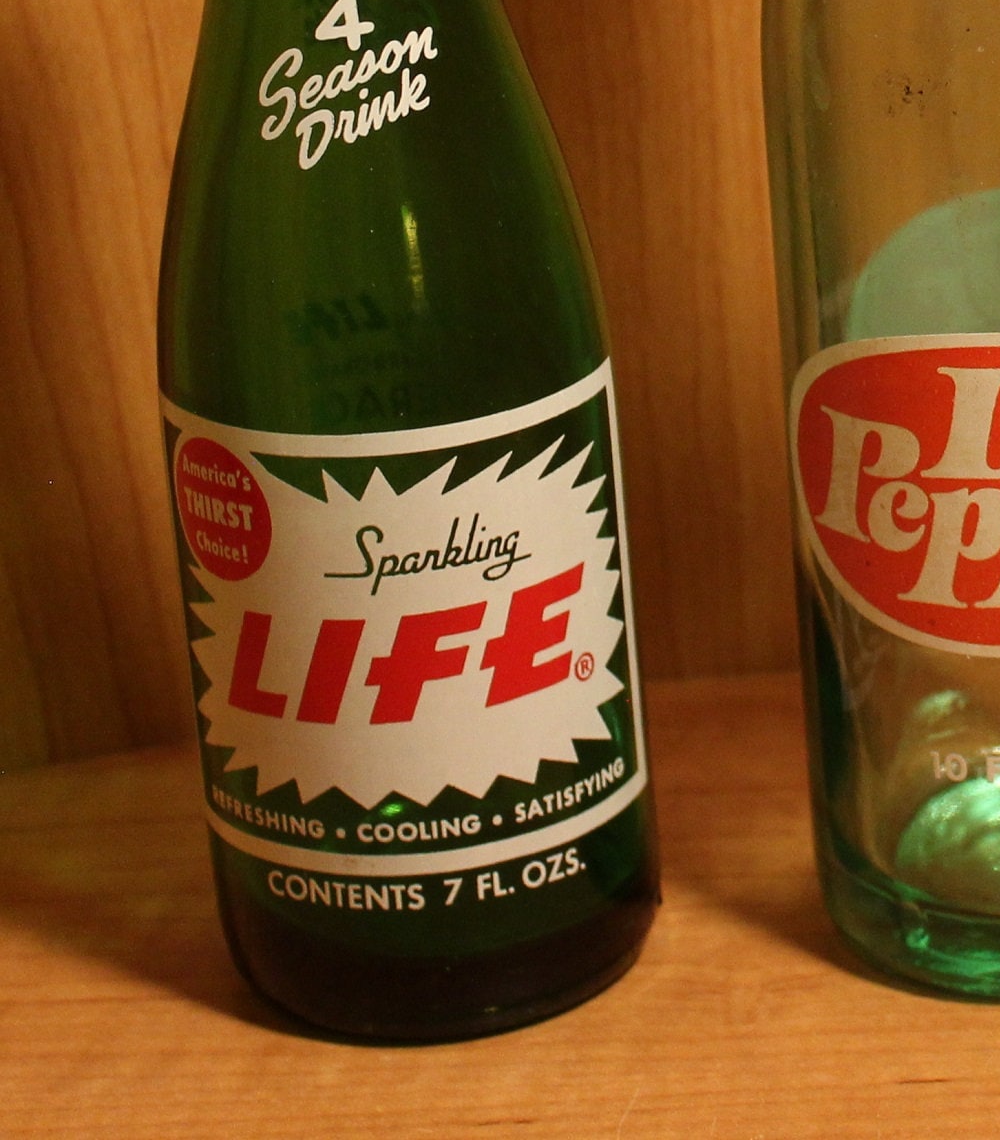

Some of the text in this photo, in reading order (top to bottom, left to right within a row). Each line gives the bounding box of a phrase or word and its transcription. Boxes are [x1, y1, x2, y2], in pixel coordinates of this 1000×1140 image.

[258, 25, 438, 141] Season
[295, 67, 431, 171] Drink
[182, 453, 252, 492] America's
[183, 486, 253, 532] THIRST
[195, 529, 249, 564] Choice!
[324, 512, 532, 596] Sparkling
[227, 561, 585, 726] LIFE
[356, 813, 482, 843] COOLING
[514, 757, 626, 823] SATISFYING
[929, 749, 968, 782] 10
[267, 847, 587, 911] CONTENTS 7 FL. OZS.
